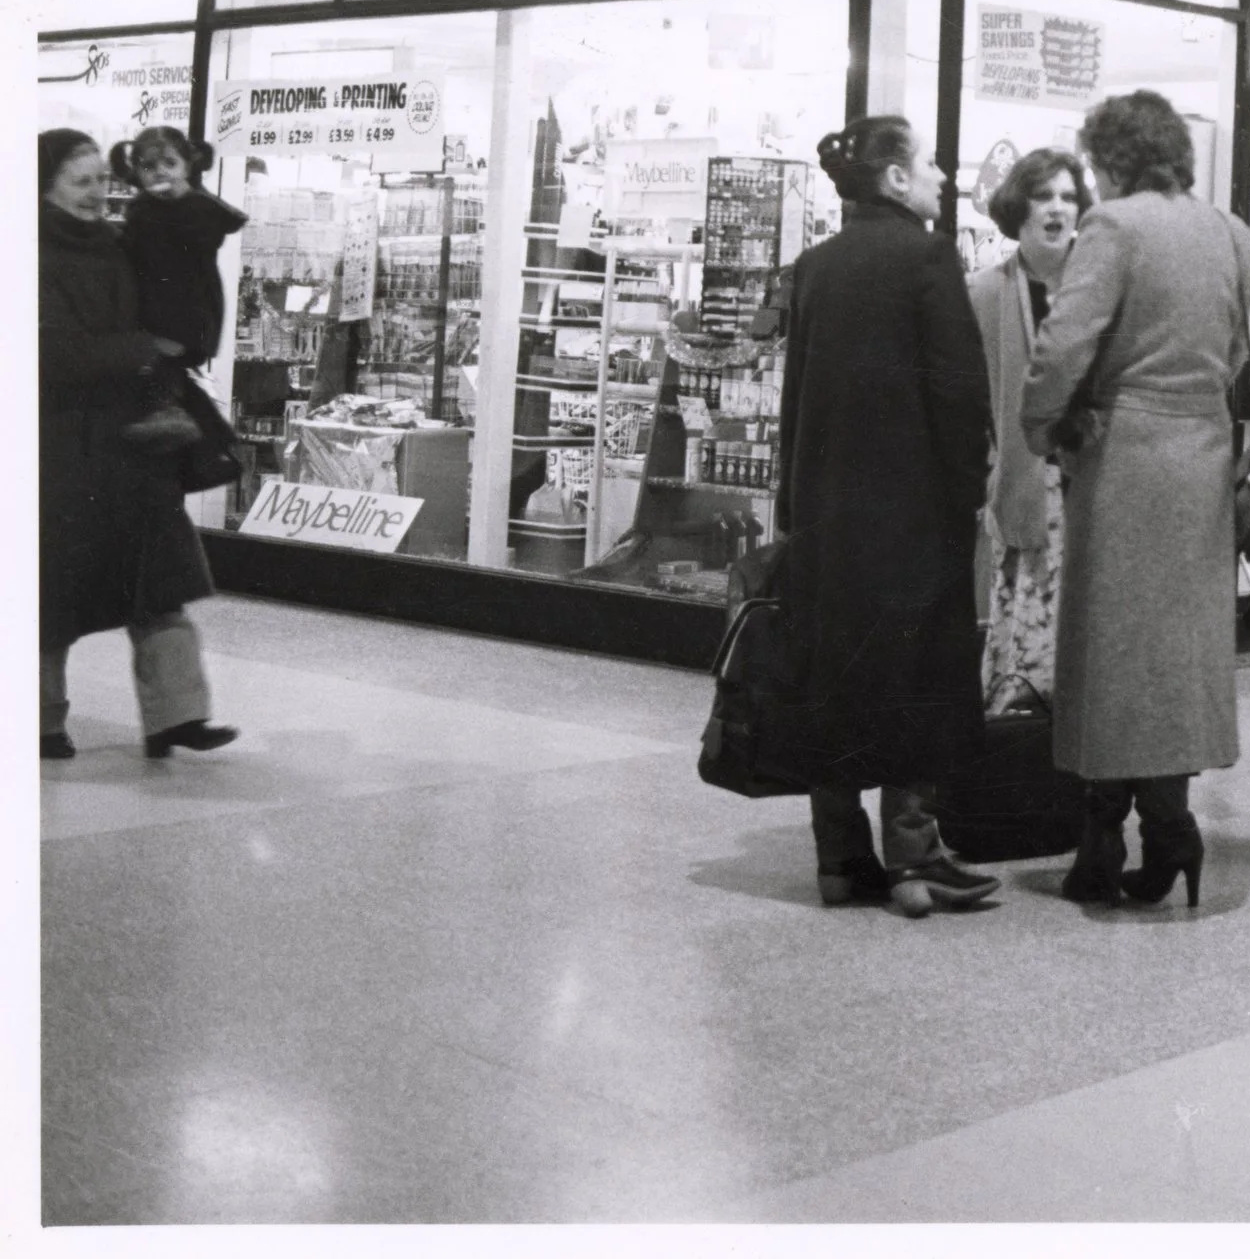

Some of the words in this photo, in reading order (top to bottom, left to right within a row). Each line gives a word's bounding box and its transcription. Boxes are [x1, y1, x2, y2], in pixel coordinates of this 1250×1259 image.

[981, 12, 1022, 30] SUPER
[981, 31, 1035, 49] SAVINGS
[112, 69, 146, 87] PHOTO
[161, 90, 191, 104] SPECIA
[250, 86, 327, 115] DEVELOPING
[341, 82, 407, 110] PRINTING
[250, 130, 277, 146] £1.99
[288, 129, 314, 145] £2.99
[366, 127, 395, 142] £4.99
[623, 161, 696, 189] Maybelline
[254, 484, 405, 538] Maybelline
